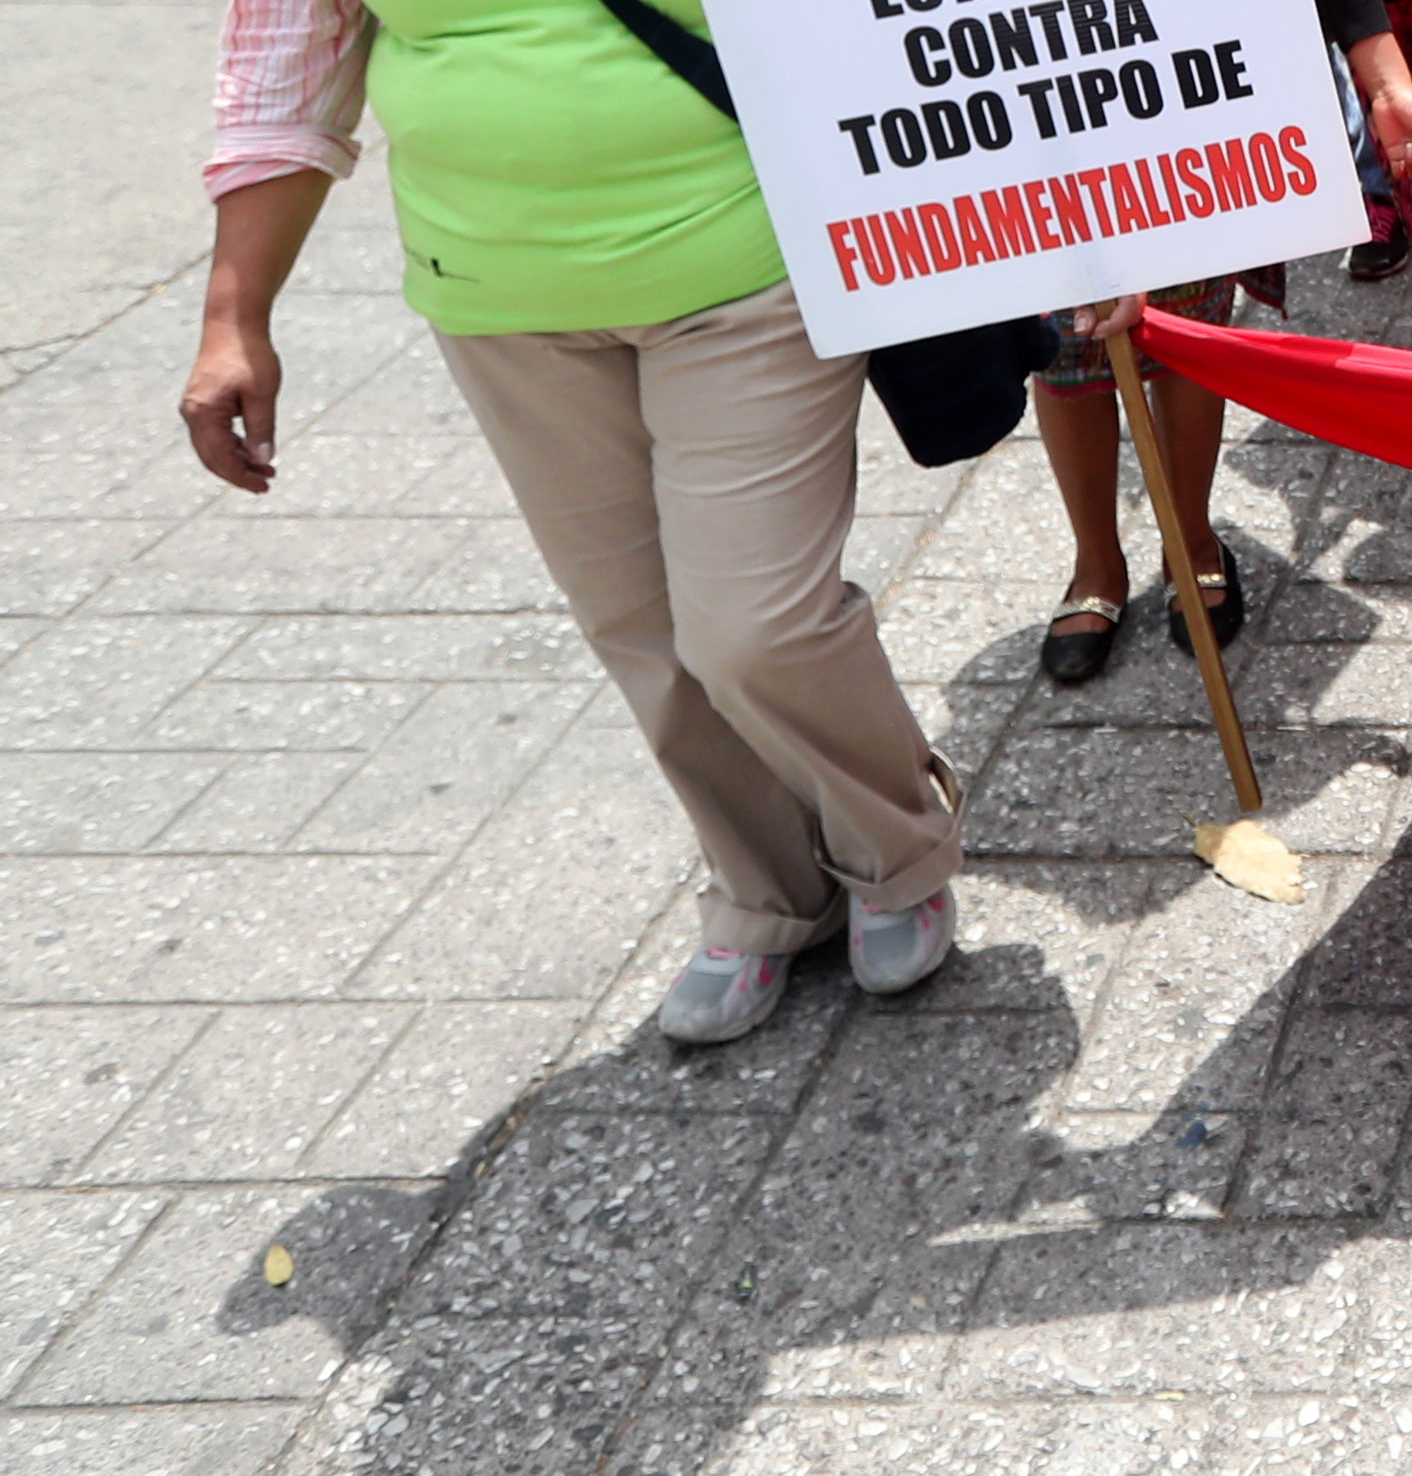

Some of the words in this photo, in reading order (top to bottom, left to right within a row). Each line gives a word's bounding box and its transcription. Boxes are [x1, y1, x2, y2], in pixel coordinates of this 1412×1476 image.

[837, 90, 1013, 176] TODO
[1017, 59, 1164, 140] TIPO
[1171, 39, 1254, 110] DE
[825, 124, 1318, 293] FUNDAMENTALISMOS
